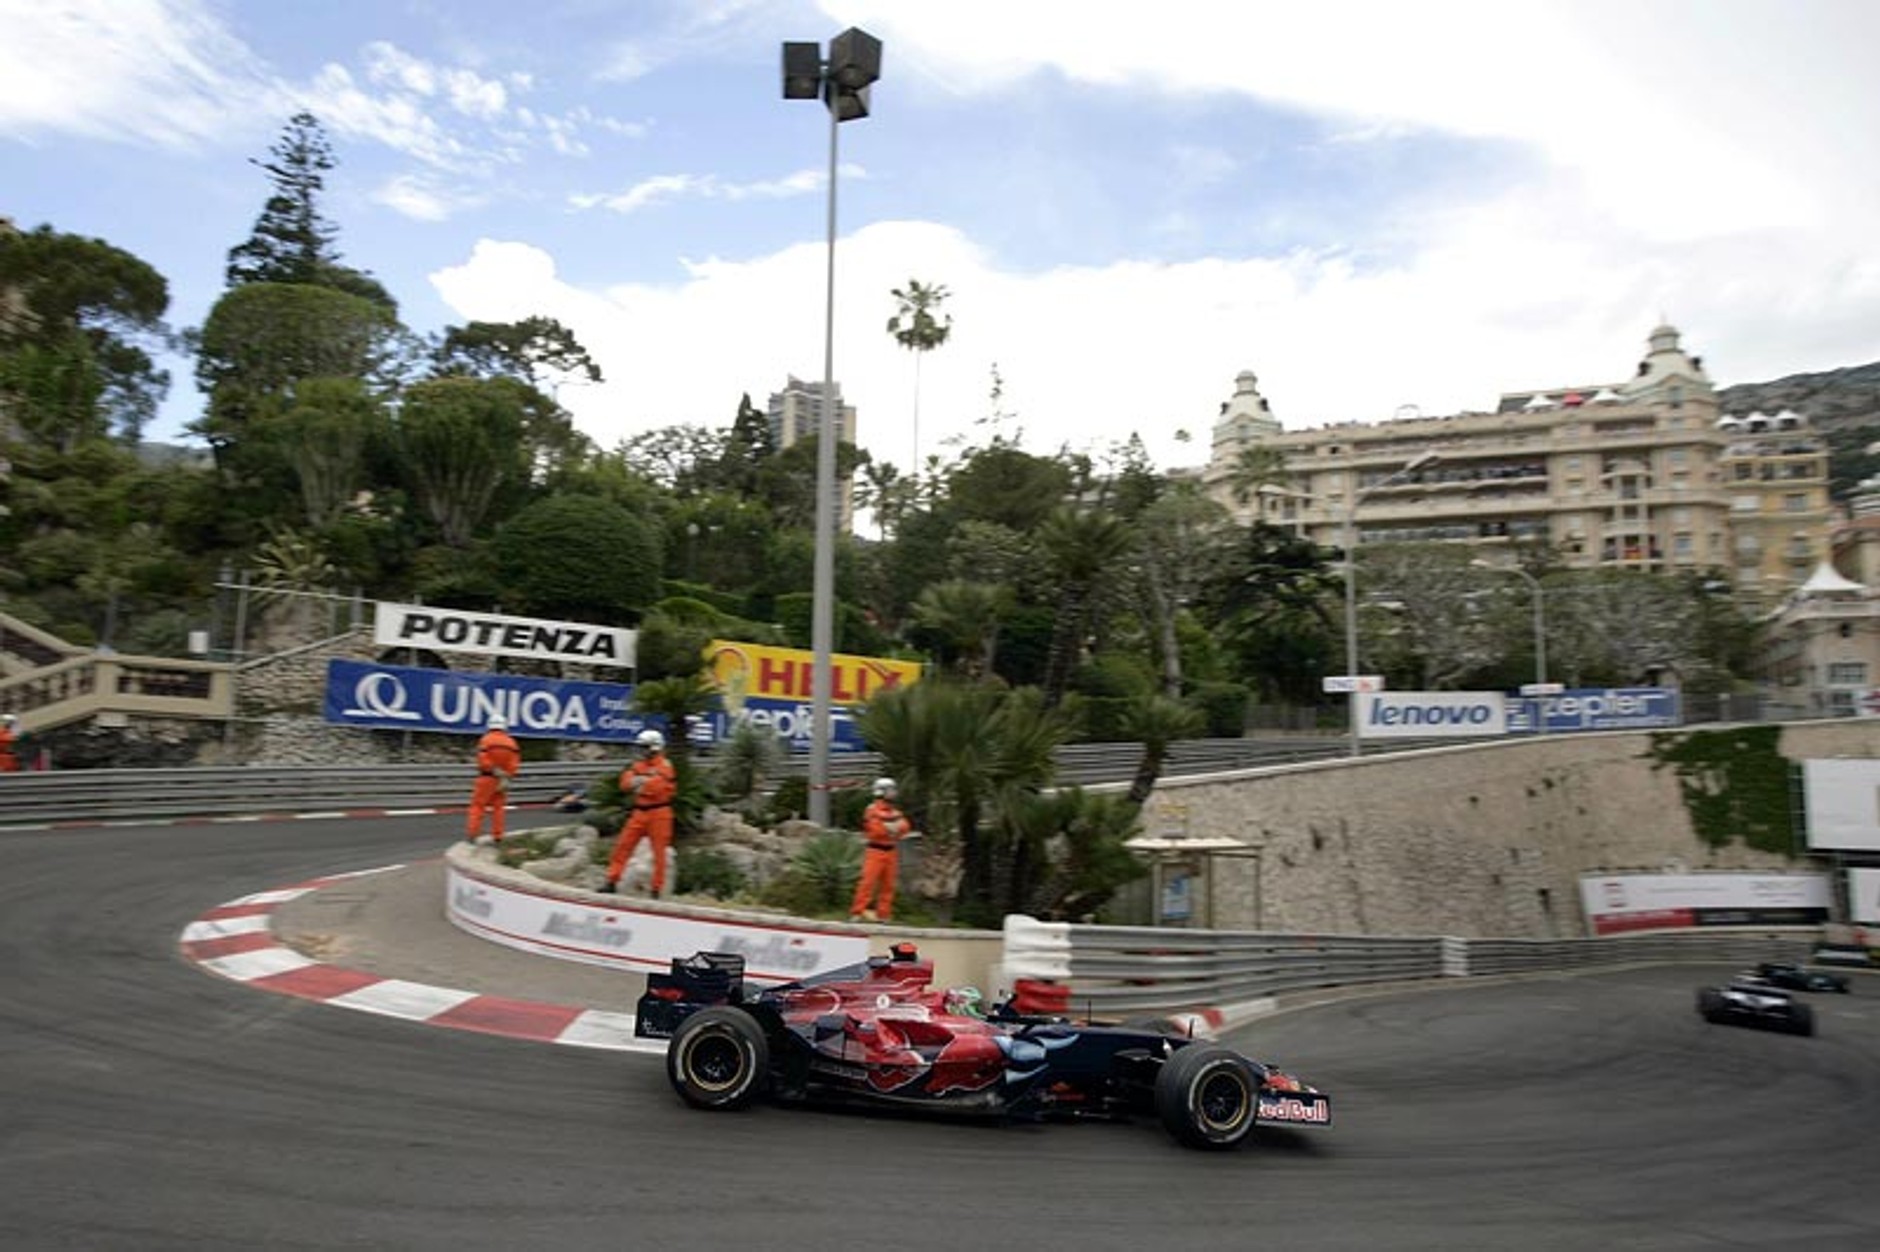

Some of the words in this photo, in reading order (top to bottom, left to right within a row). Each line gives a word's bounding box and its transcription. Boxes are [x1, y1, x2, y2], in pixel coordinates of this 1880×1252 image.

[402, 613, 616, 659] POTENZA
[430, 683, 591, 732] UNIQA
[1370, 698, 1491, 726] lenovo
